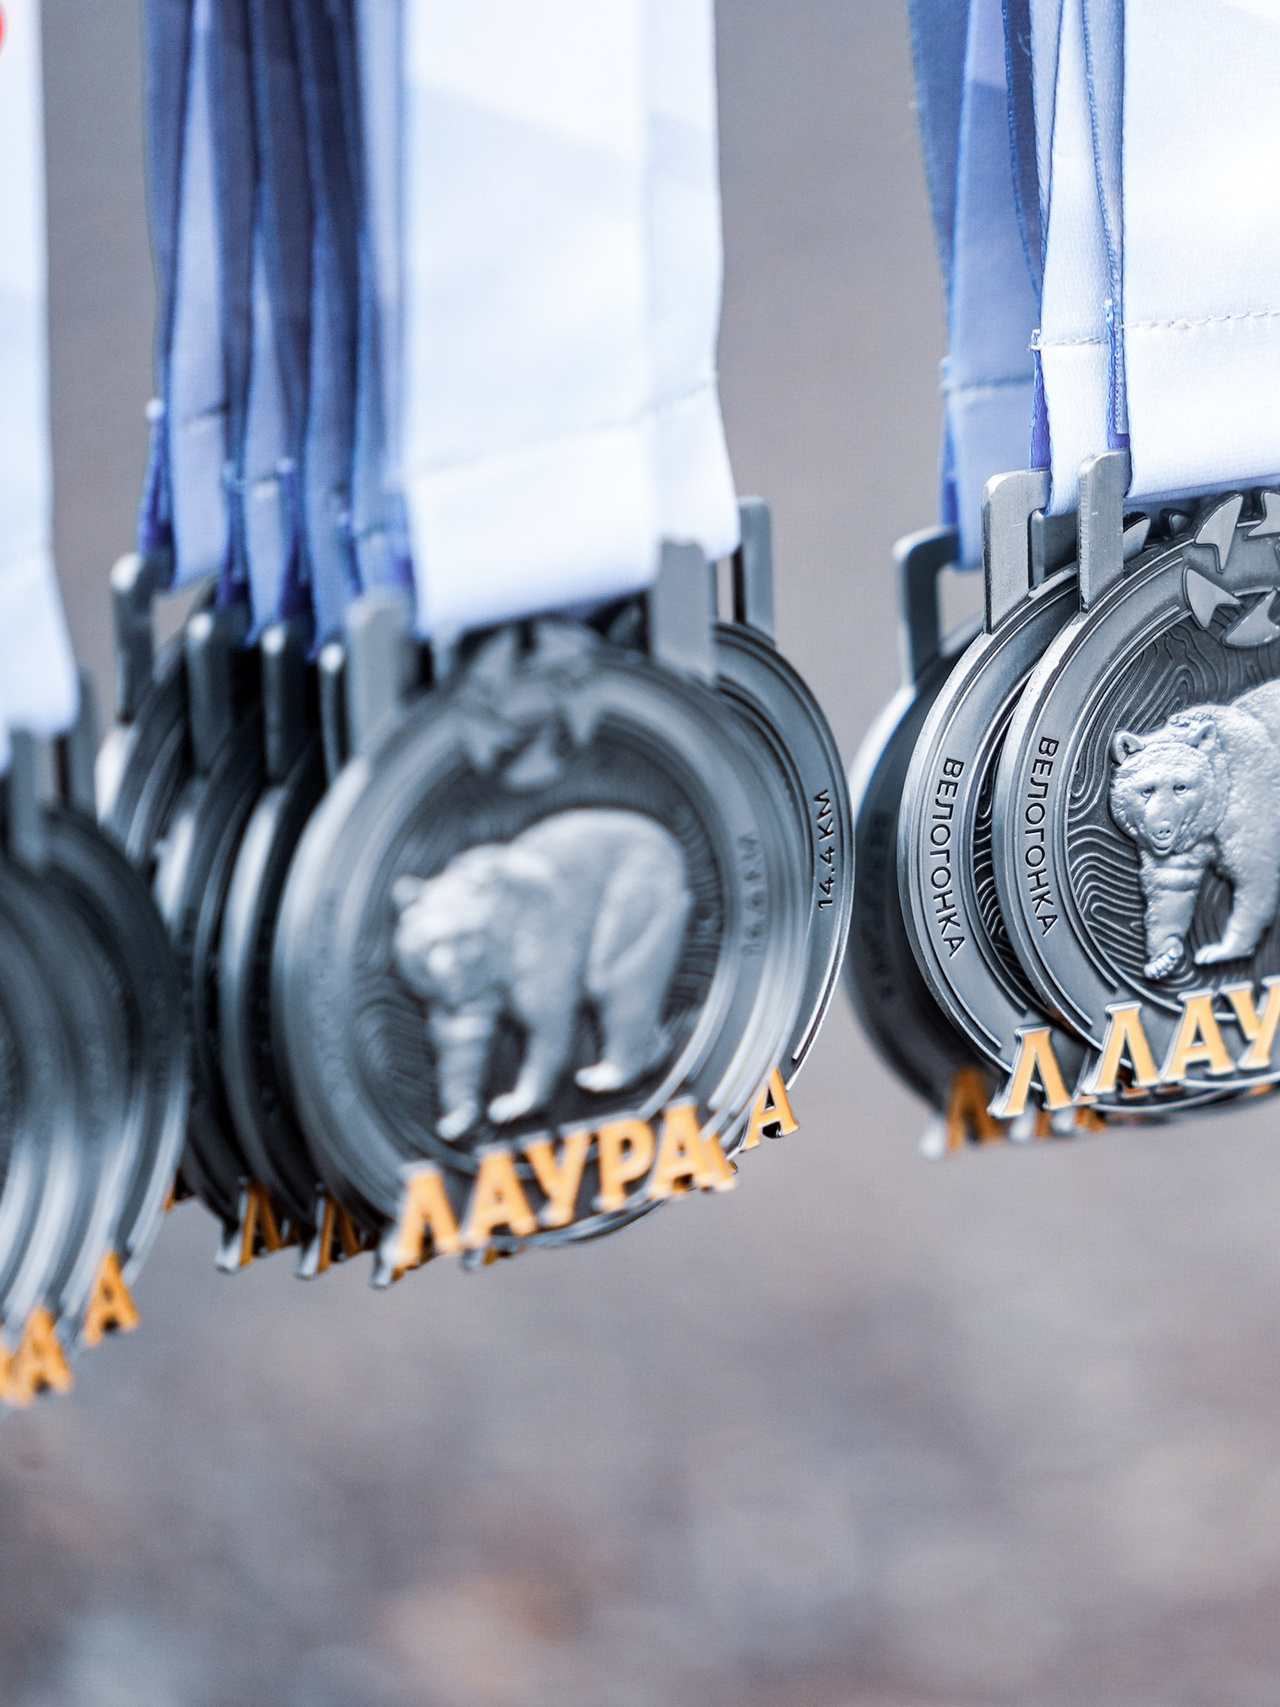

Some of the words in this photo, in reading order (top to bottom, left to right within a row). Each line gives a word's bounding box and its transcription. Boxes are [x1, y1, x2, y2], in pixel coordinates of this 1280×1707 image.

[818, 846, 835, 911] 14.4
[930, 757, 966, 959] ВЕЛОГОНКА
[1025, 736, 1060, 937] ВЕЛОГОНКА
[390, 1097, 718, 1275] ЛАУРА
